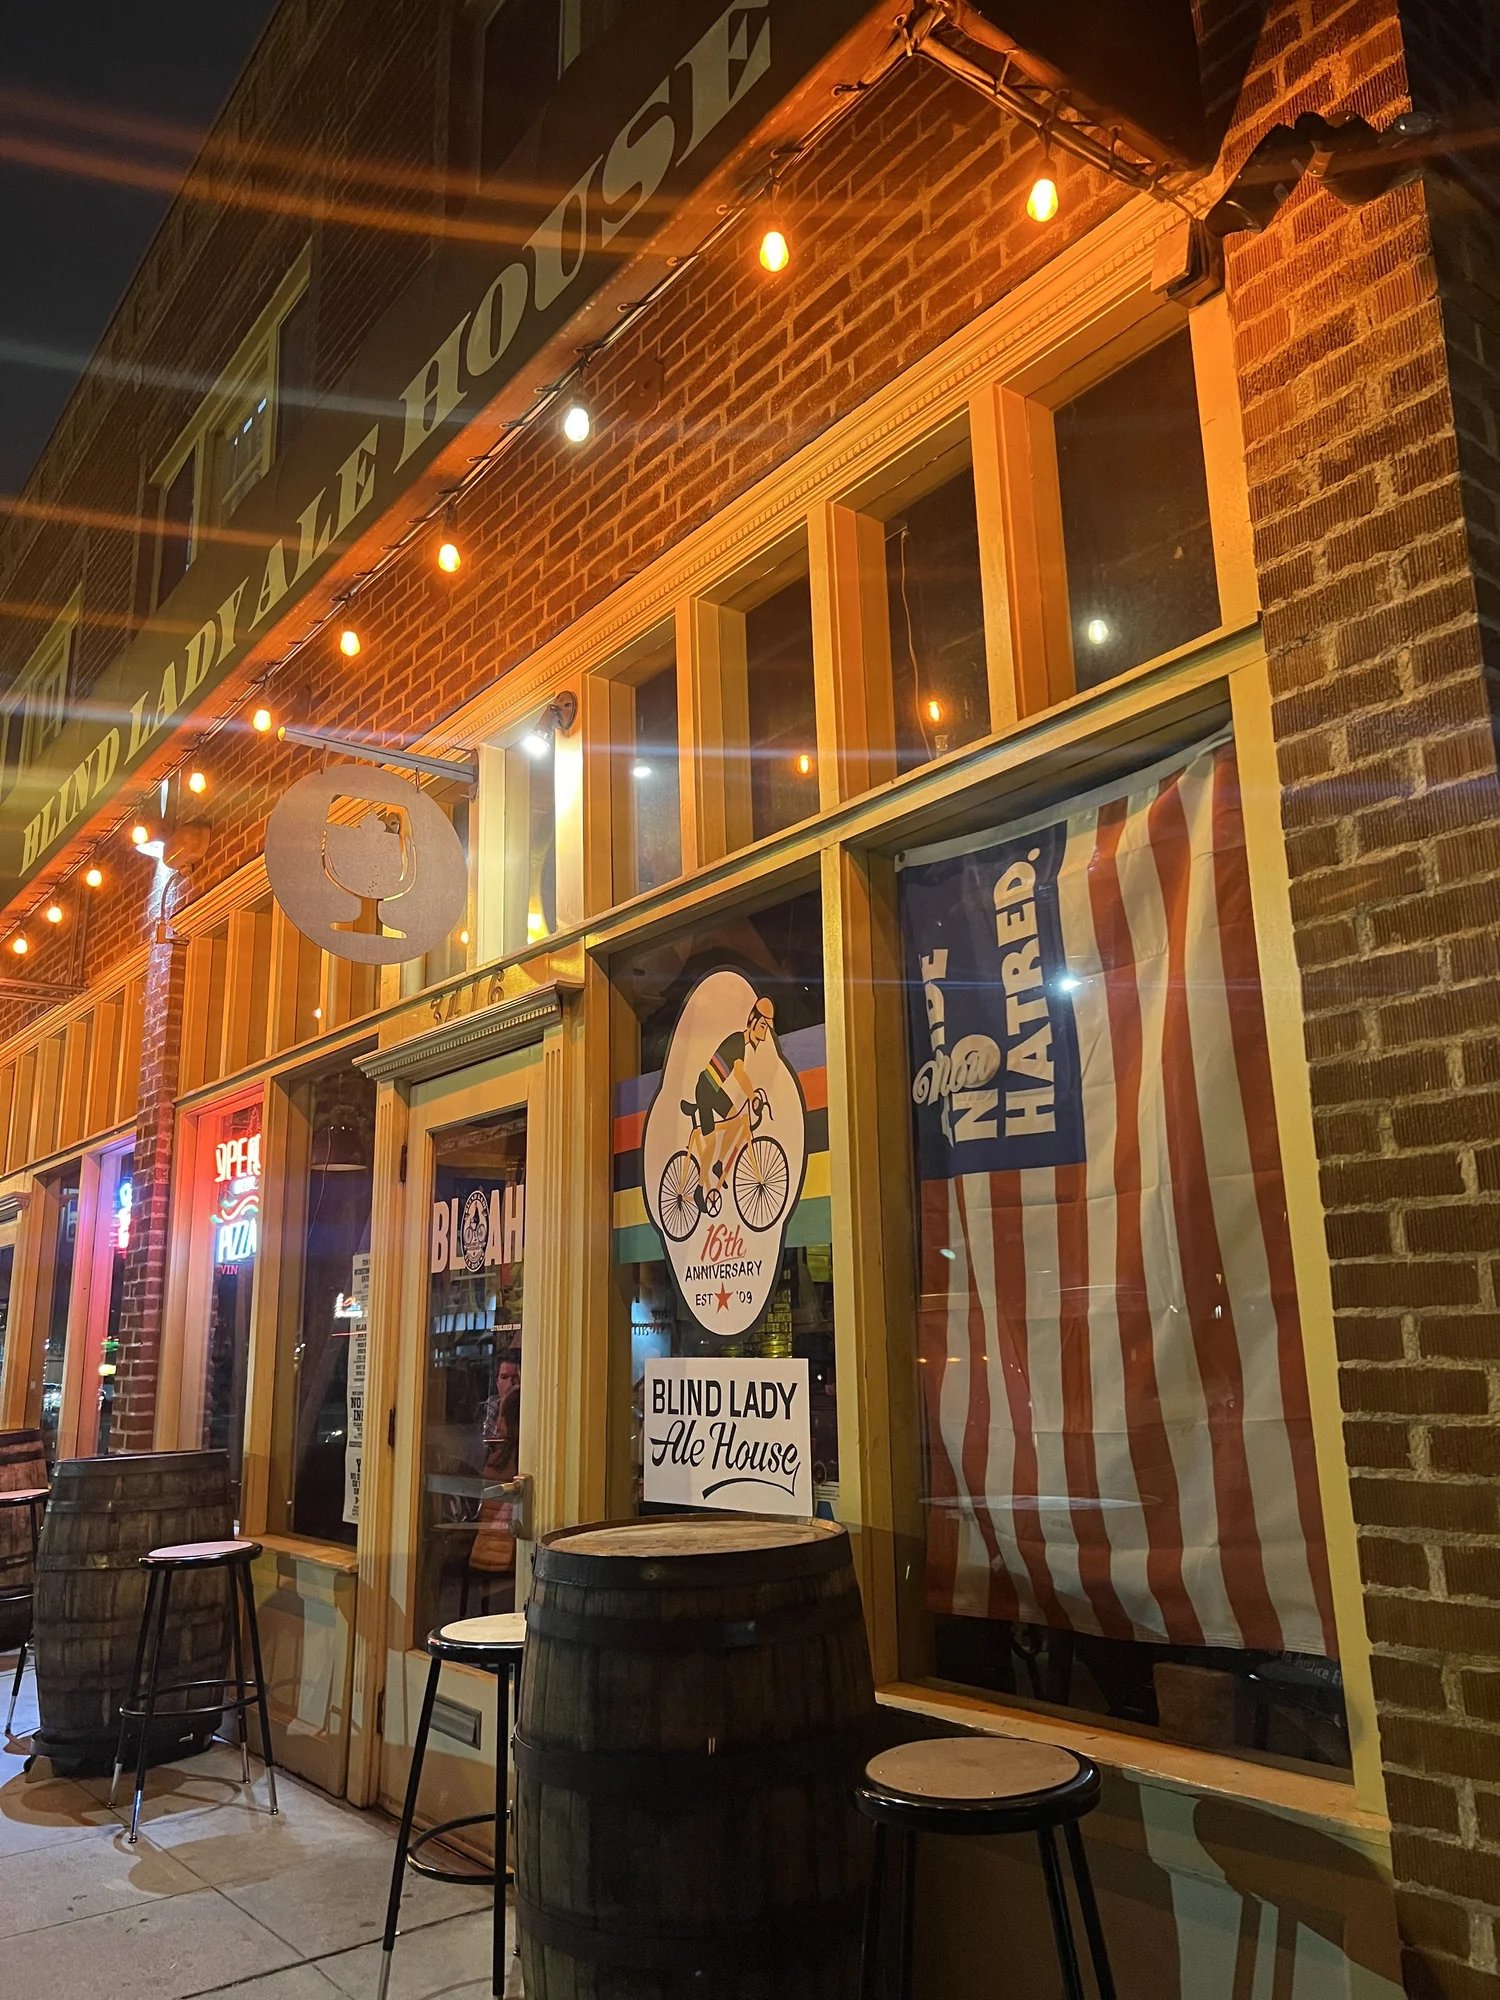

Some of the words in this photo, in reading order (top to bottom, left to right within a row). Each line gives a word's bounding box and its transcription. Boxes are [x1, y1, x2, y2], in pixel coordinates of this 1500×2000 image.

[18, 728, 120, 877] BLIND
[124, 576, 249, 766] LADY
[248, 423, 379, 632] ALE
[394, 0, 771, 474] HOUSE
[994, 848, 1056, 1137] HATRED.
[701, 1223, 747, 1262] 16th
[685, 1260, 762, 1282] ANNIVERSARY
[696, 1293, 713, 1306] EST
[652, 1379, 722, 1417] BLIND
[729, 1380, 798, 1420] LADY
[648, 1420, 705, 1467] Ale
[709, 1421, 801, 1476] House
